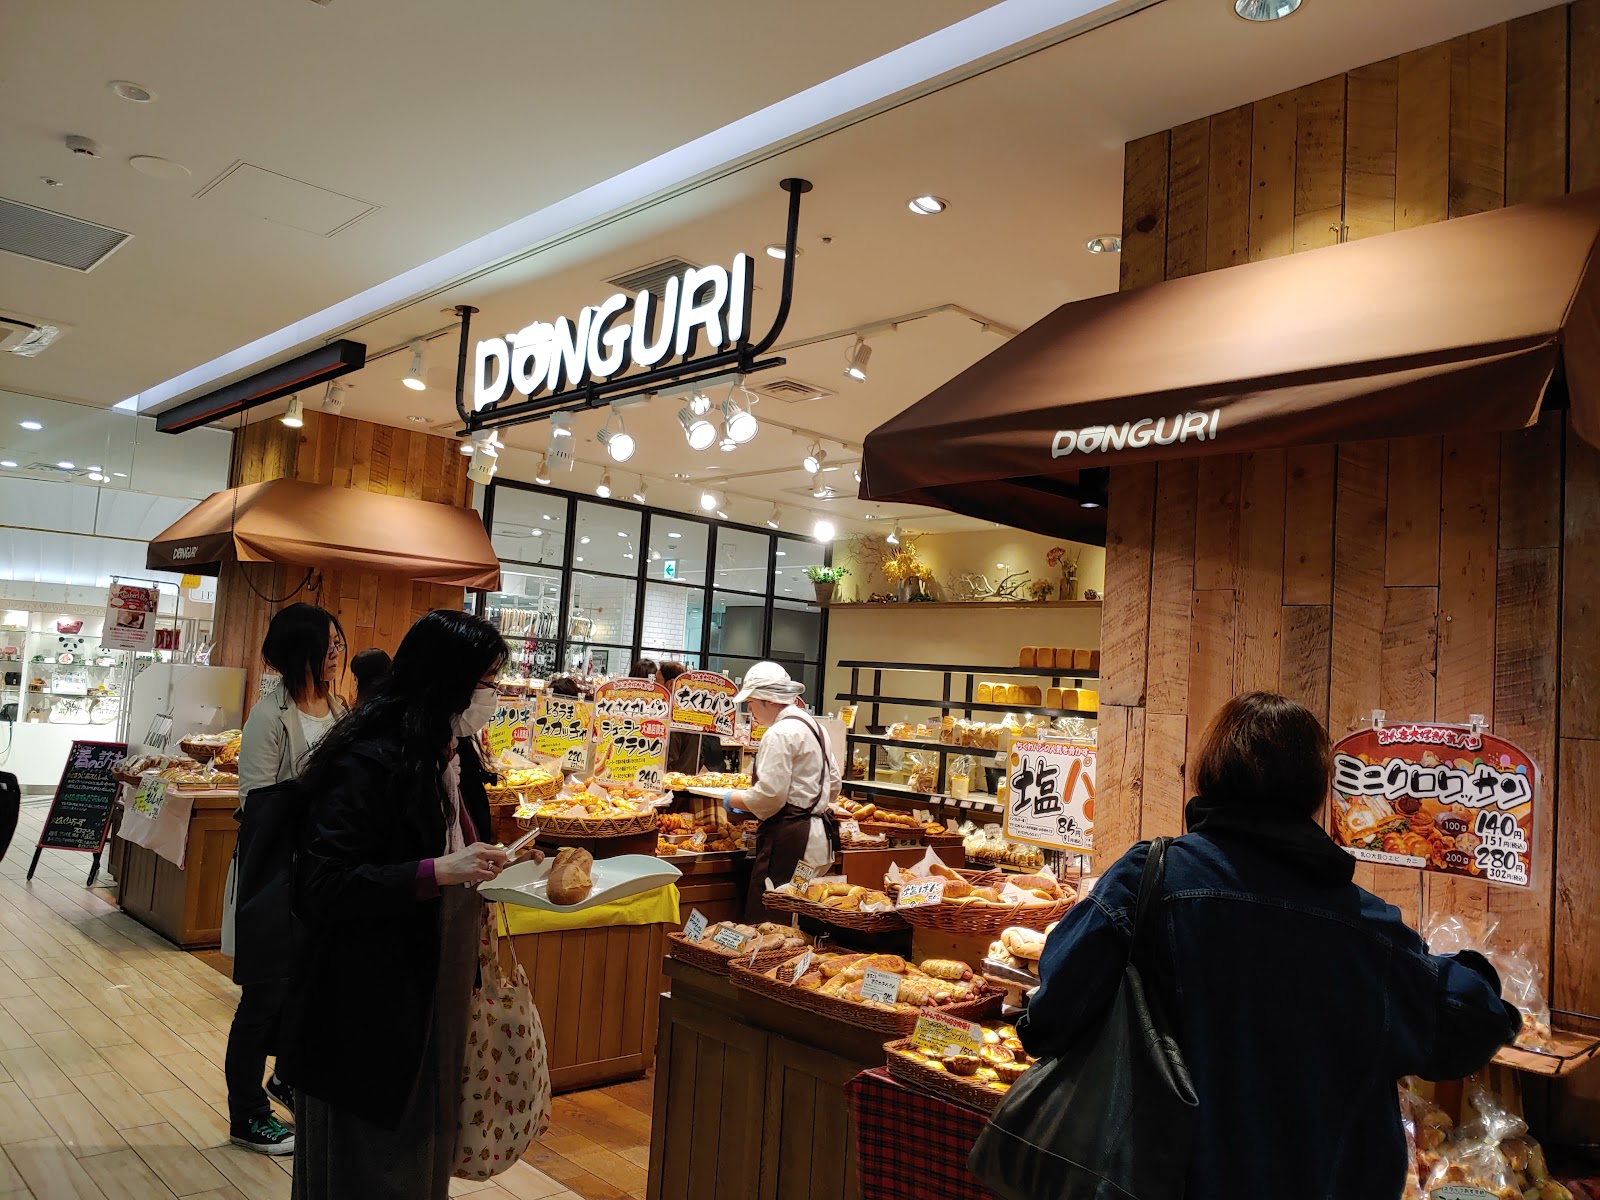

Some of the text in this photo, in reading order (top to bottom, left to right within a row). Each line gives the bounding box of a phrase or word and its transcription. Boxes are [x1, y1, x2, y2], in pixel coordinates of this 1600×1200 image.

[474, 252, 749, 412] DONGURI
[1052, 409, 1220, 459] DONGURI
[677, 687, 735, 714] ちくわパン
[536, 717, 588, 741] フォカッチャ
[613, 735, 663, 757] フランク
[1336, 757, 1528, 805] ミニクロワッサン
[1057, 817, 1081, 838] 85円
[1477, 812, 1522, 840] 140円
[1476, 847, 1523, 872] 280円
